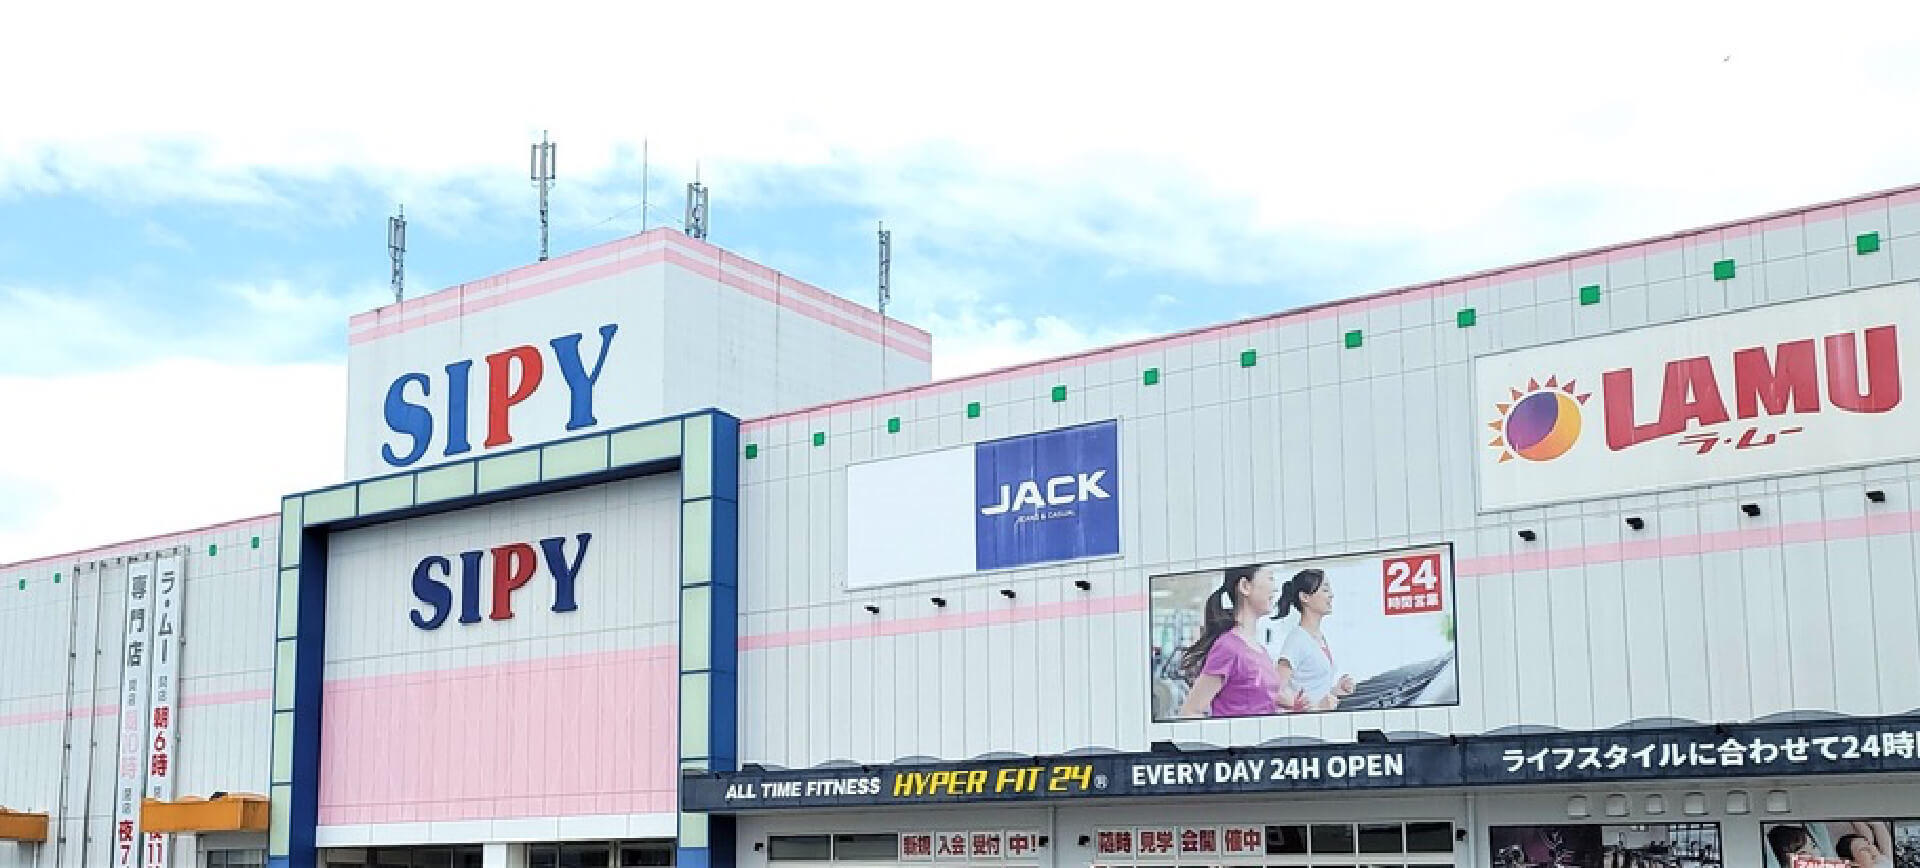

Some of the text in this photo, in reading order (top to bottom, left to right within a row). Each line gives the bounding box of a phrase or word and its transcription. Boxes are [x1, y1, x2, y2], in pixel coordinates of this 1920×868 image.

[382, 324, 619, 467] SIPY
[1602, 324, 1901, 452] LAMU
[1678, 426, 1803, 455] ラ・ムー
[981, 467, 1111, 515] JACK
[410, 533, 592, 631] SIPY
[1387, 560, 1437, 593] 24
[127, 574, 148, 667] 専門店
[151, 706, 169, 777] 朝6時
[1502, 731, 1920, 773] ライフスタイルに合わせて24時
[725, 776, 881, 801] ALL TIME FITNESS
[894, 770, 989, 797] HYPER
[995, 766, 1046, 793] FIT
[1048, 764, 1093, 791] 24
[1132, 753, 1403, 786] EVERY DAY 24H OPEN
[118, 820, 134, 868] 夜7
